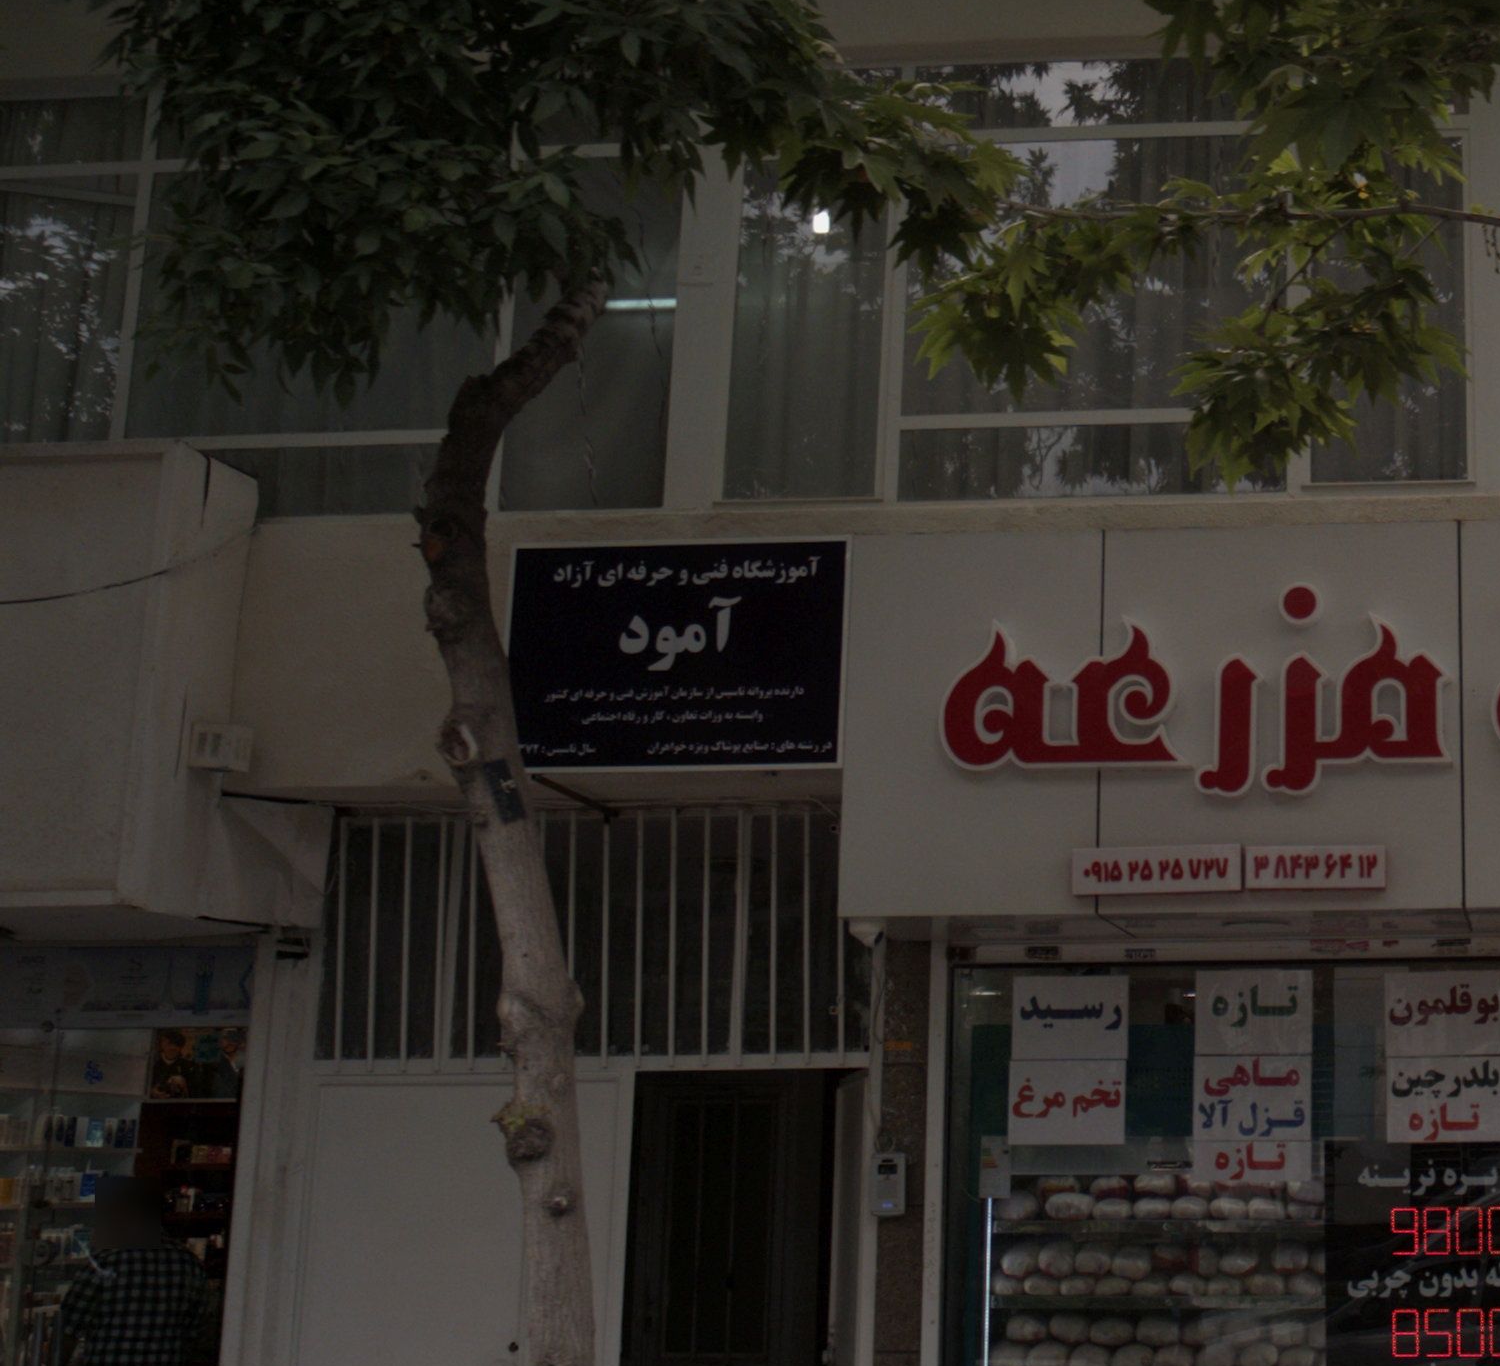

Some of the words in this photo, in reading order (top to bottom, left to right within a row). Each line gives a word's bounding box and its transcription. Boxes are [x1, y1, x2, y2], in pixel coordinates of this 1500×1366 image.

[552, 560, 595, 588] آزاد
[597, 563, 623, 587] ای
[626, 560, 674, 587] حرفه
[677, 568, 690, 586] و
[691, 558, 729, 585] فنی
[732, 555, 822, 584] آموزشگاه
[617, 595, 742, 672] آمود
[941, 583, 1450, 795] مزرعه
[1083, 860, 1123, 882] ۰۹۱۵
[1020, 996, 1122, 1030] رسید
[1211, 984, 1298, 1028] تازه
[1204, 1057, 1300, 1097] ماهی
[1392, 1060, 1500, 1099] بلدرچین
[1012, 1077, 1066, 1119] مرغ
[1072, 1080, 1122, 1118] تخم
[1198, 1098, 1233, 1129] آلا
[1238, 1099, 1306, 1137] قزل
[1409, 1102, 1480, 1141] تازه
[1215, 1143, 1286, 1180] تازه
[1357, 1158, 1437, 1195] نرینه
[1443, 1165, 1499, 1194] بره
[1347, 1267, 1412, 1299] چربی
[1418, 1268, 1478, 1298] بدون
